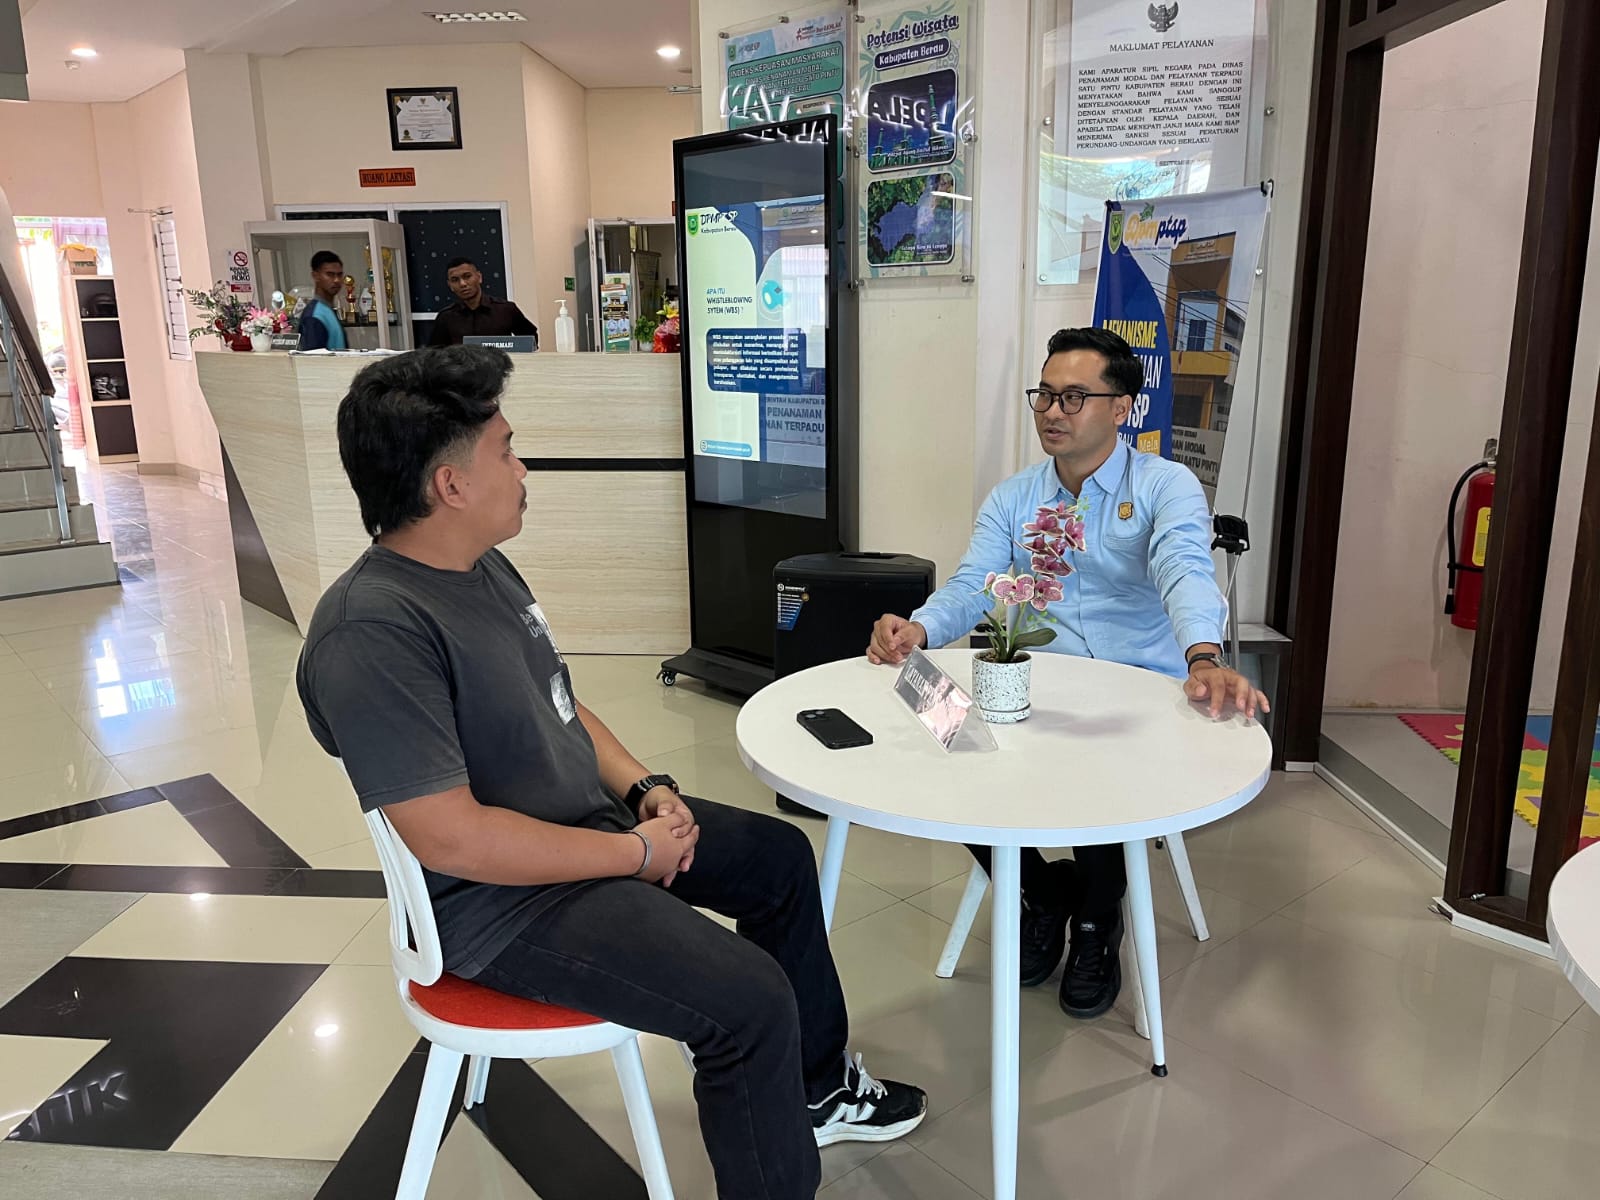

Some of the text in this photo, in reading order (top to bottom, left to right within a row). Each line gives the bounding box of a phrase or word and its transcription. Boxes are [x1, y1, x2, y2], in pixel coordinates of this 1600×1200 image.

[867, 14, 959, 49] Potensi Wisata
[1109, 39, 1214, 52] MAKLUMAT PELAYANAN
[879, 43, 944, 66] Kabupaten Berau
[1101, 67, 1137, 75] APARATUR
[1078, 76, 1120, 84] PENANAMAN
[1125, 82, 1165, 90] KABUPATEN
[1199, 79, 1228, 87] DENGAN
[1078, 92, 1123, 100] MENYATAKAN
[1137, 90, 1162, 98] BAHWA
[1209, 86, 1242, 94] SANGGUP
[1078, 94, 1241, 109] MENYELENGGARAKAN PELAYANAN SESUAI
[1077, 109, 1106, 117] DENGAN
[1148, 105, 1187, 113] PELAYANAN
[1077, 117, 1119, 125] DITETAPKAN
[1153, 114, 1179, 122] KEPALA
[1187, 112, 1217, 120] DAERAH,
[1128, 123, 1161, 131] MENEPATI
[1199, 128, 1239, 136] PERATURAN
[1077, 140, 1157, 149] PERUNDANG-UNDANGAN
[1178, 137, 1211, 145] BERLAKU.
[706, 297, 753, 305] WHISTLEBLOWING
[707, 306, 724, 314] SYTEM
[767, 406, 822, 420] PENANAMAN
[784, 420, 825, 433] TERPADU
[1184, 440, 1206, 455] MODAL
